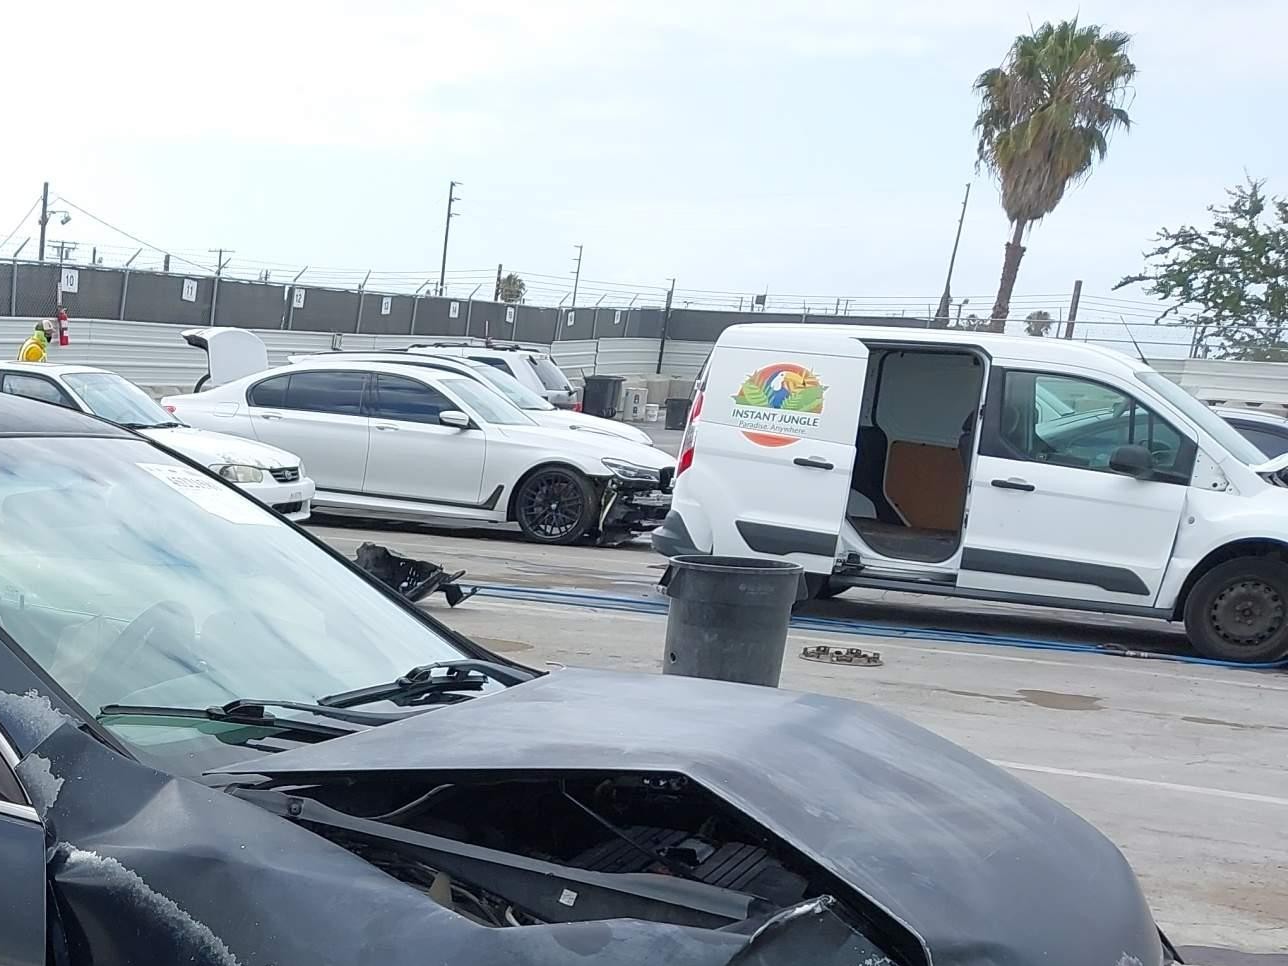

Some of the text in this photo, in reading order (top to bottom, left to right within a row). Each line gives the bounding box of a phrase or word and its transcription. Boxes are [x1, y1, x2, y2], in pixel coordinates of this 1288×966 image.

[65, 273, 75, 287] 10
[186, 284, 194, 297] 11
[295, 293, 302, 304] 12
[732, 408, 820, 427] INSTANT JUNGLE
[738, 420, 808, 434] Paradise. Anywhere.
